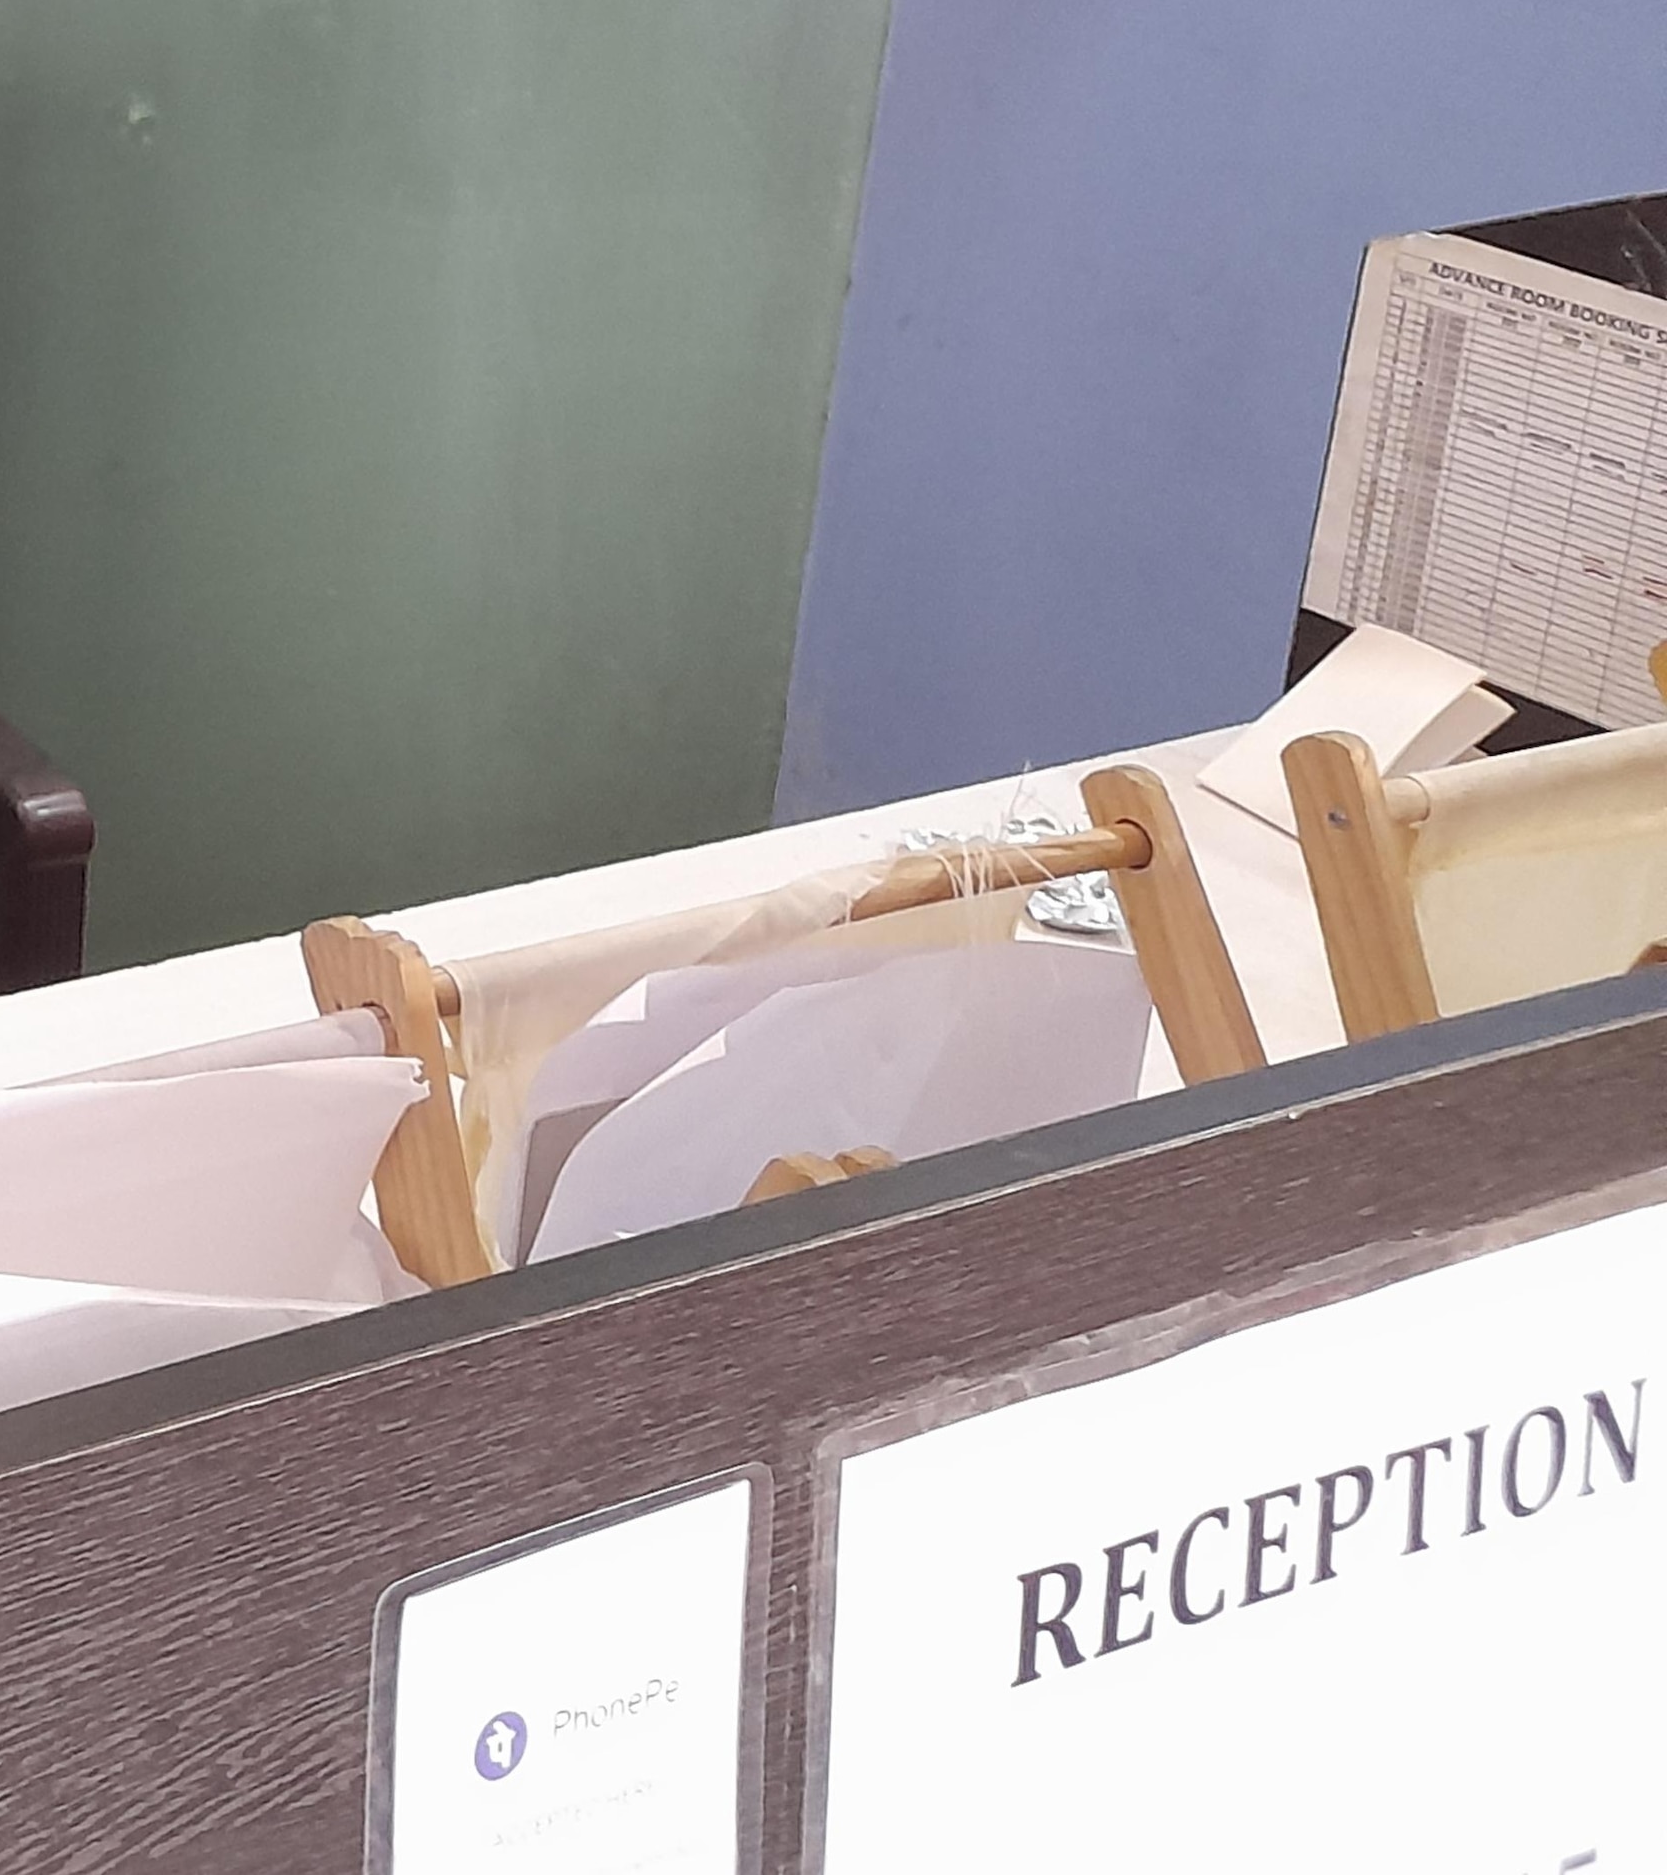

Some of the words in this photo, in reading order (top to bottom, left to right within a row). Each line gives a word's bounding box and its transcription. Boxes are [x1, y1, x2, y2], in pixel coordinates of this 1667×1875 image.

[1428, 261, 1506, 296] ADVANCE
[1509, 285, 1565, 312] ROOM
[1569, 303, 1650, 340] BOOKING
[1011, 1378, 1647, 1688] RECEPTION
[553, 1678, 680, 1738] PhonePe
